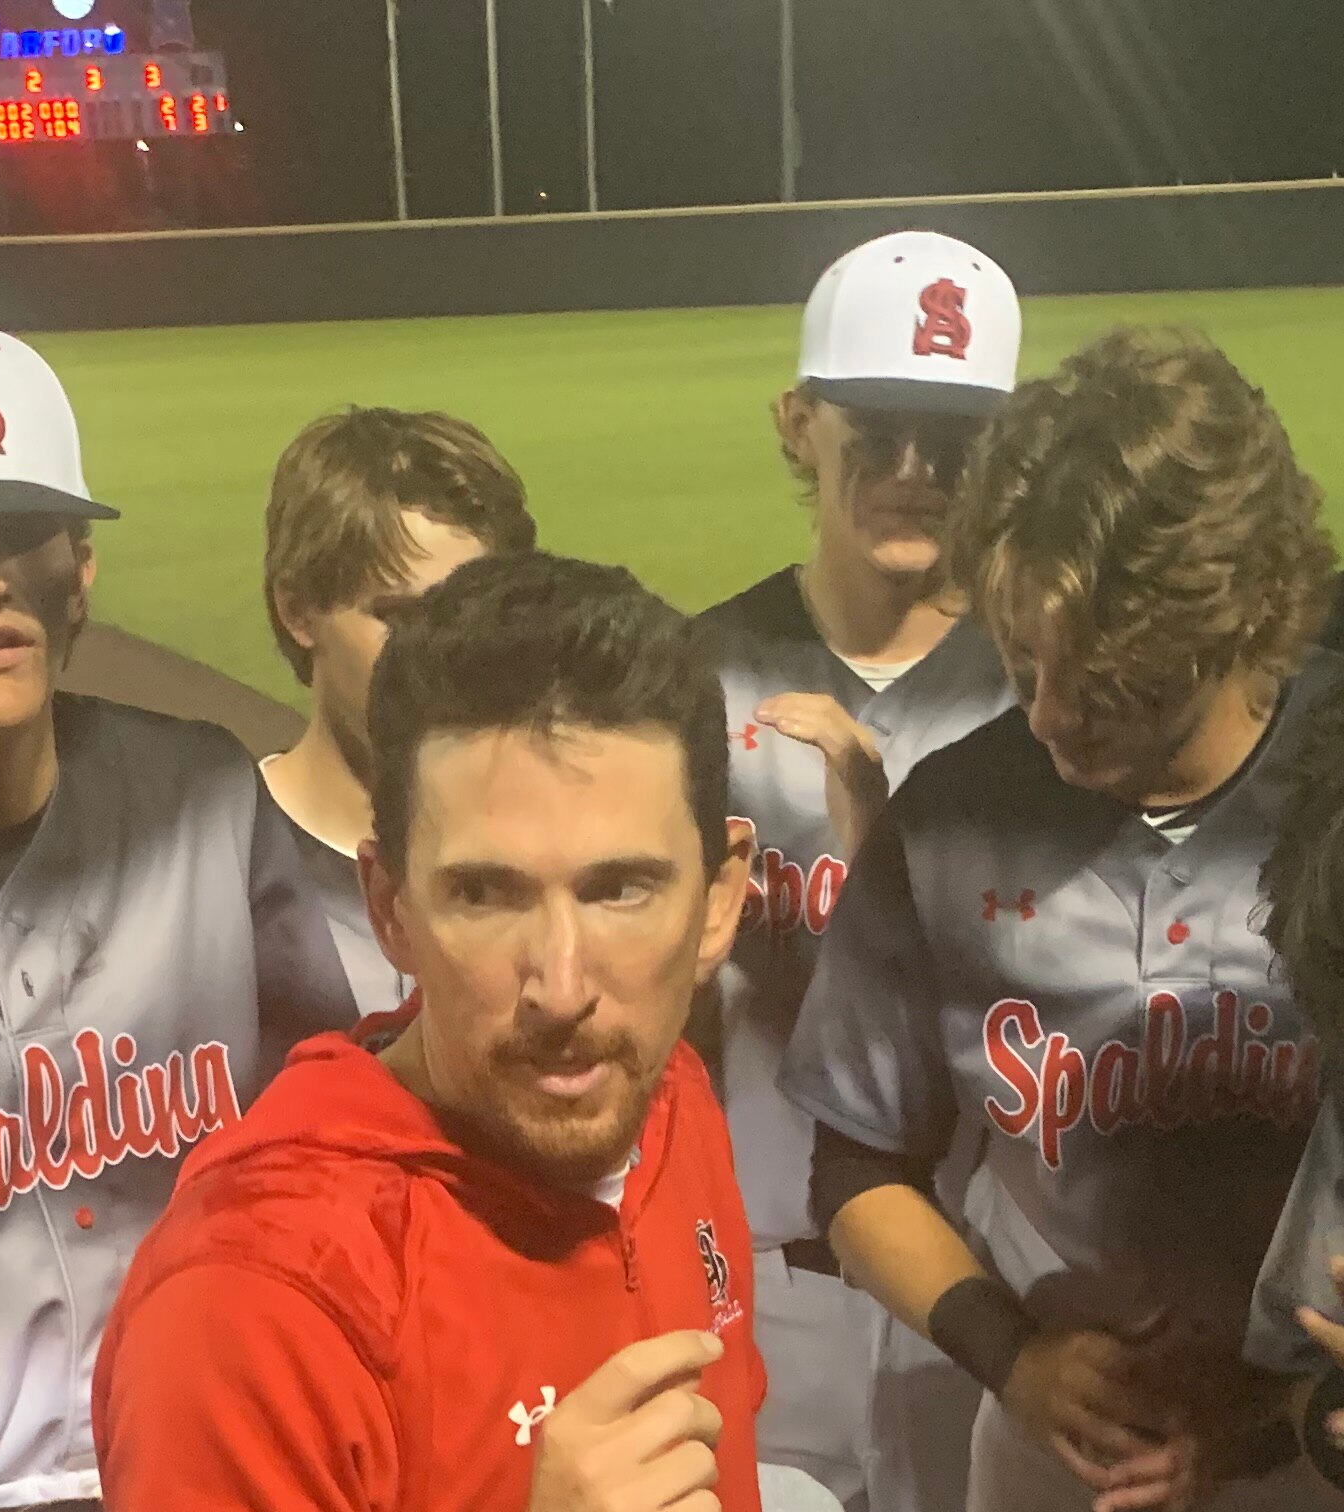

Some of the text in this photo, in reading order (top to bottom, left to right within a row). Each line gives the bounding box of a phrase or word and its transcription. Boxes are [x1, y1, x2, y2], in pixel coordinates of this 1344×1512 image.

[25, 62, 161, 93] 2 3 3
[983, 988, 1322, 1171] Spaldin
